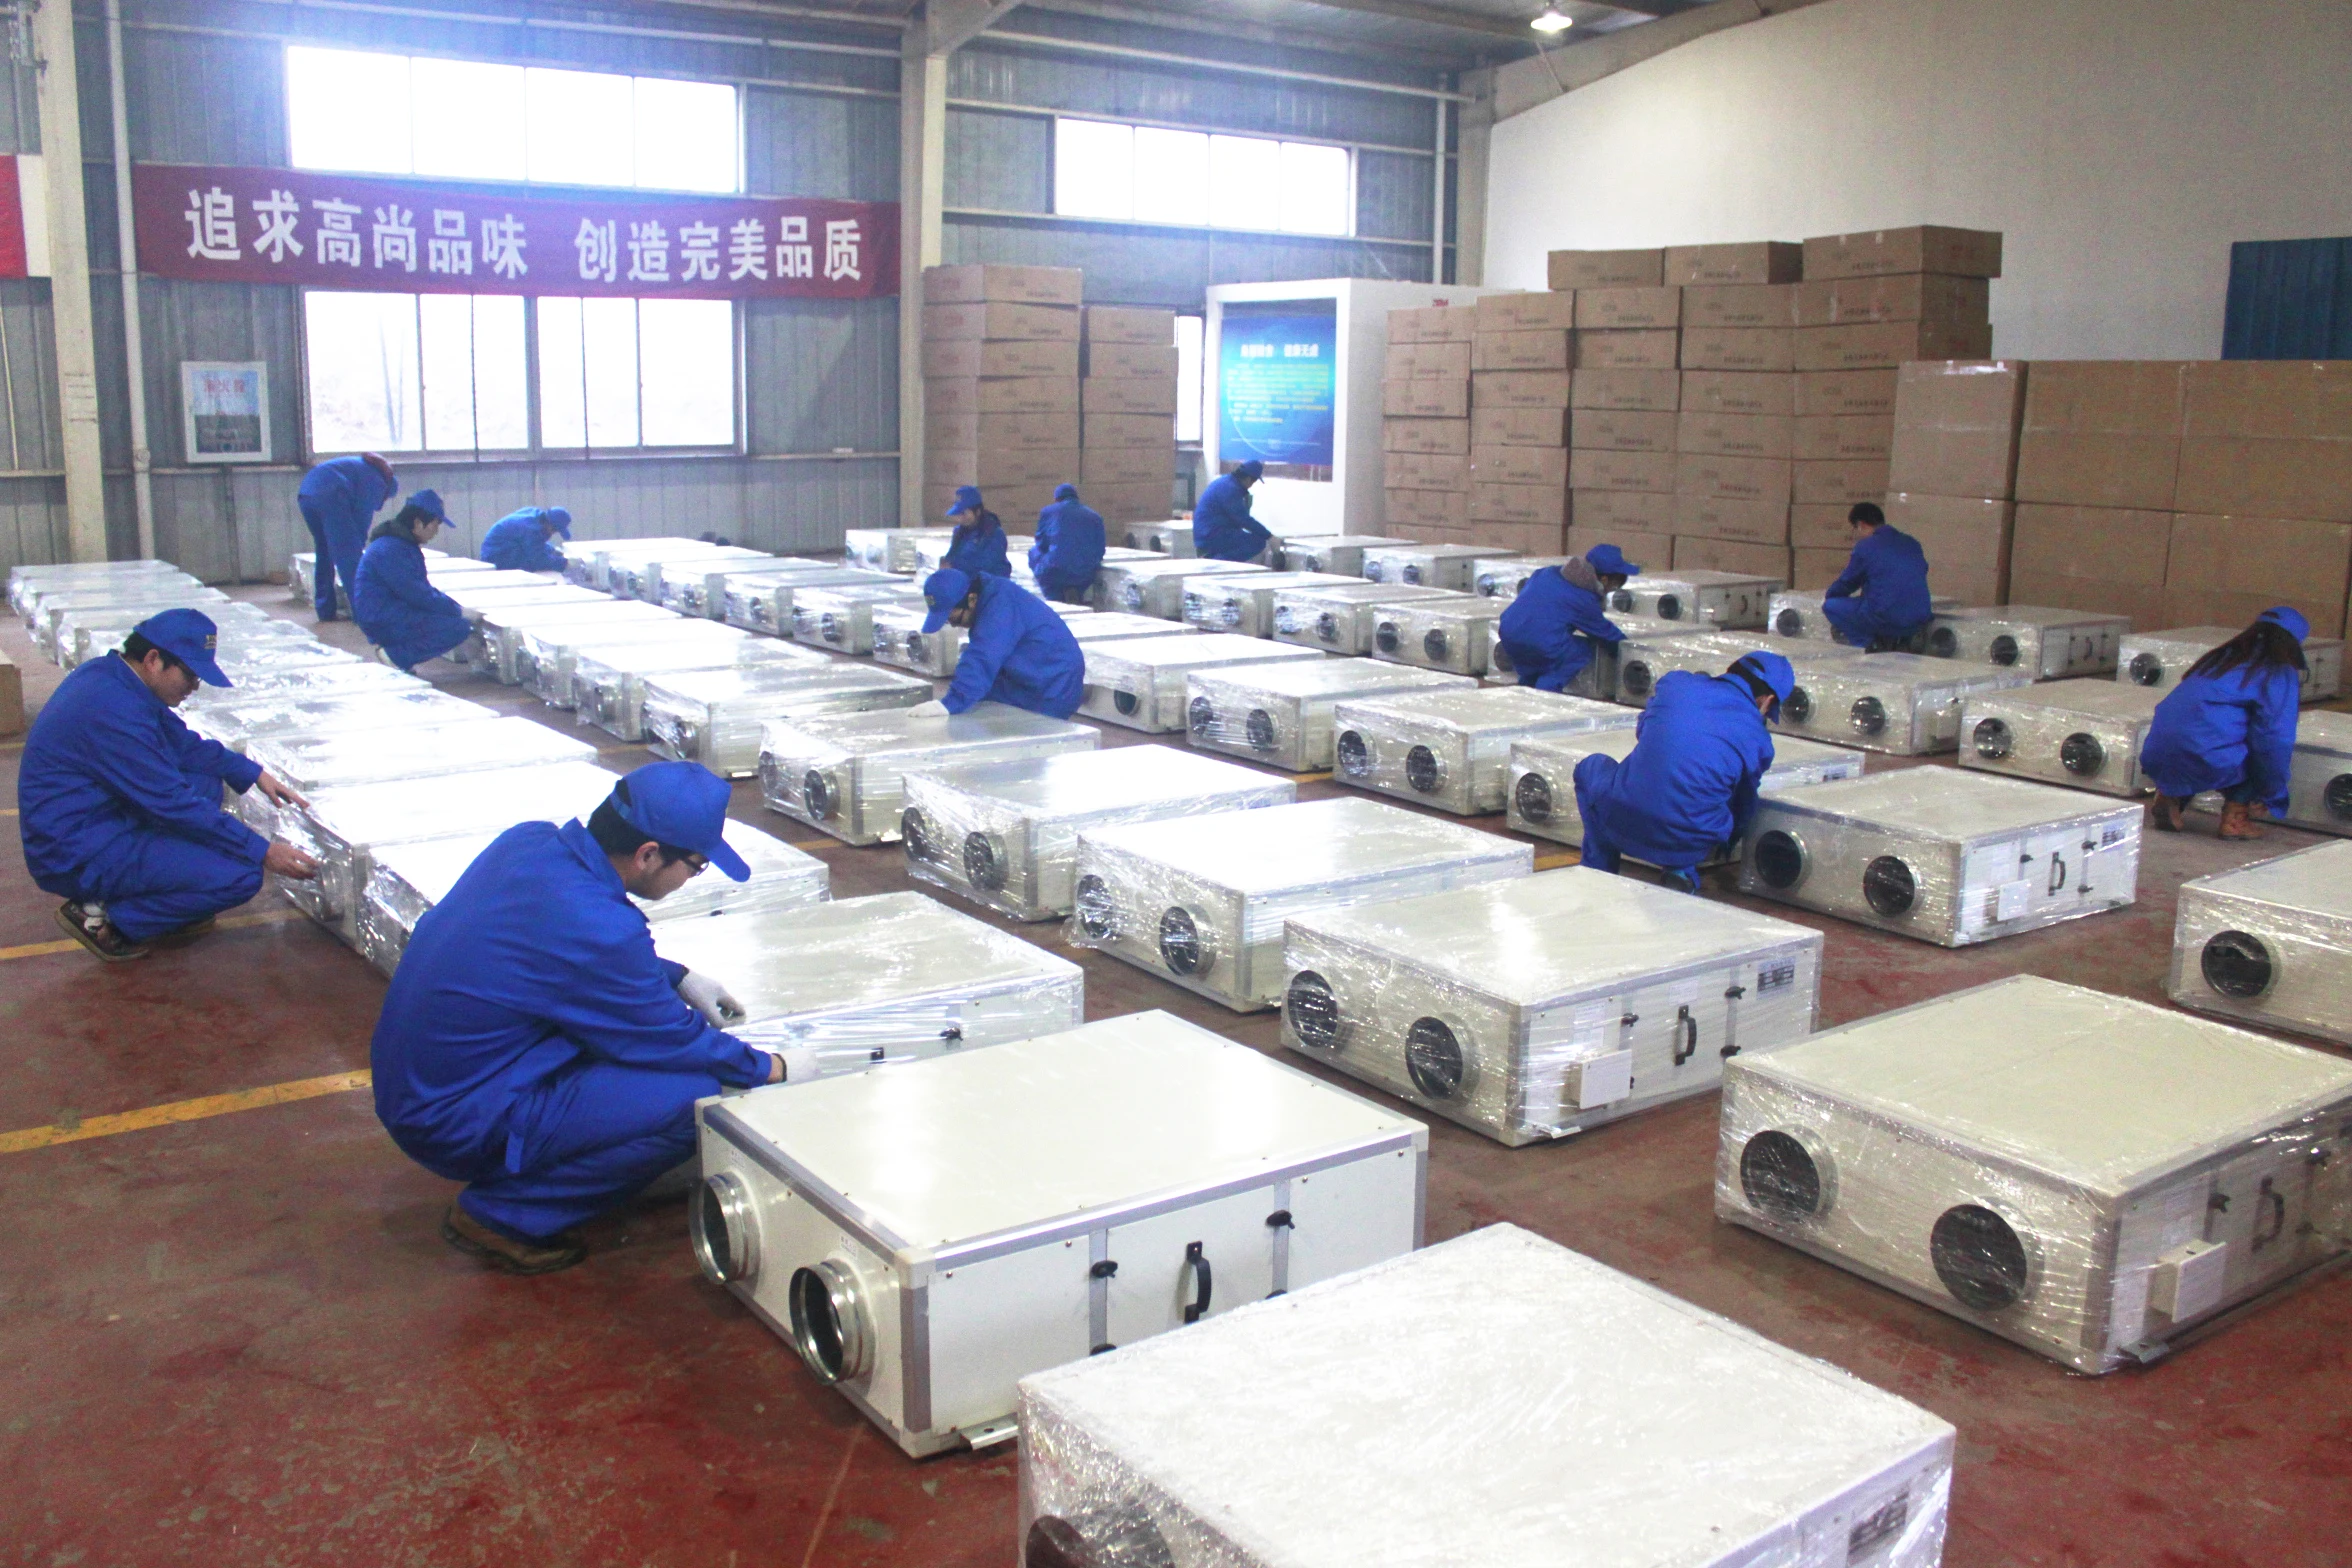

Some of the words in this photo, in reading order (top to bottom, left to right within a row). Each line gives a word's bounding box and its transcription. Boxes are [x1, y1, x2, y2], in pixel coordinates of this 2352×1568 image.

[184, 186, 528, 279] 追求高尚品味
[574, 216, 862, 283] 创造完美品质
